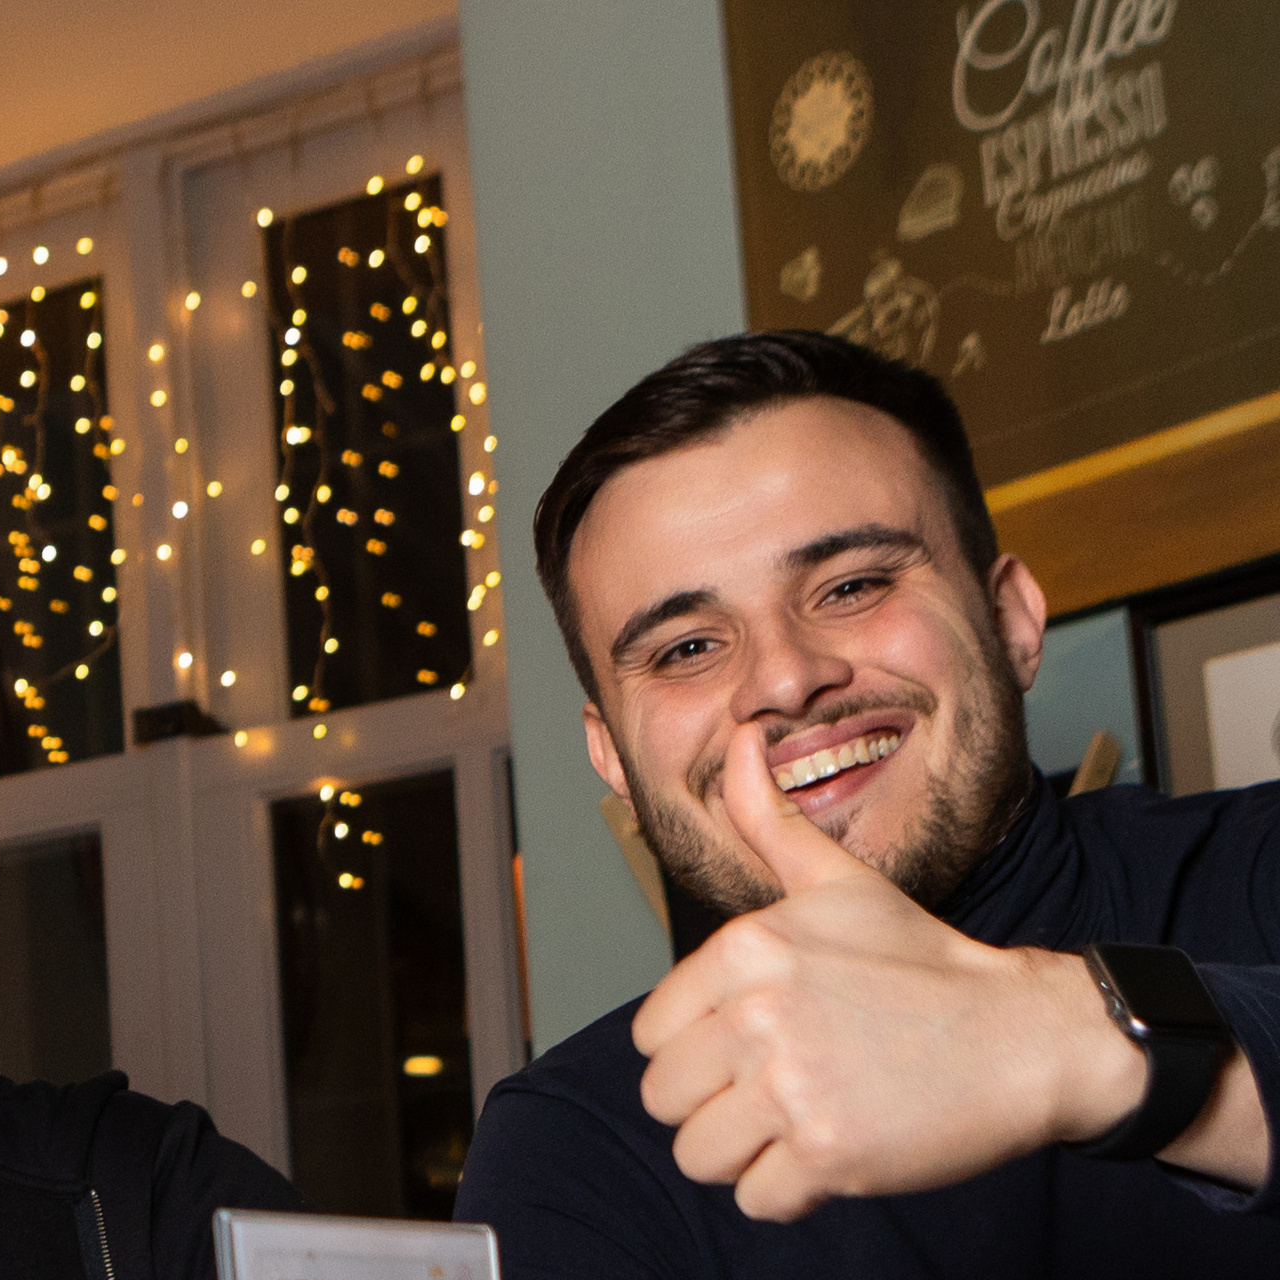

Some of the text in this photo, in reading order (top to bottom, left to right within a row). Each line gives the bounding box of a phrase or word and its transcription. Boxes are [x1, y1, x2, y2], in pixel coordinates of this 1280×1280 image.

[952, 0, 1178, 132] Coffee
[979, 62, 1168, 207] ESPRESSO
[1039, 276, 1131, 345] Latte
